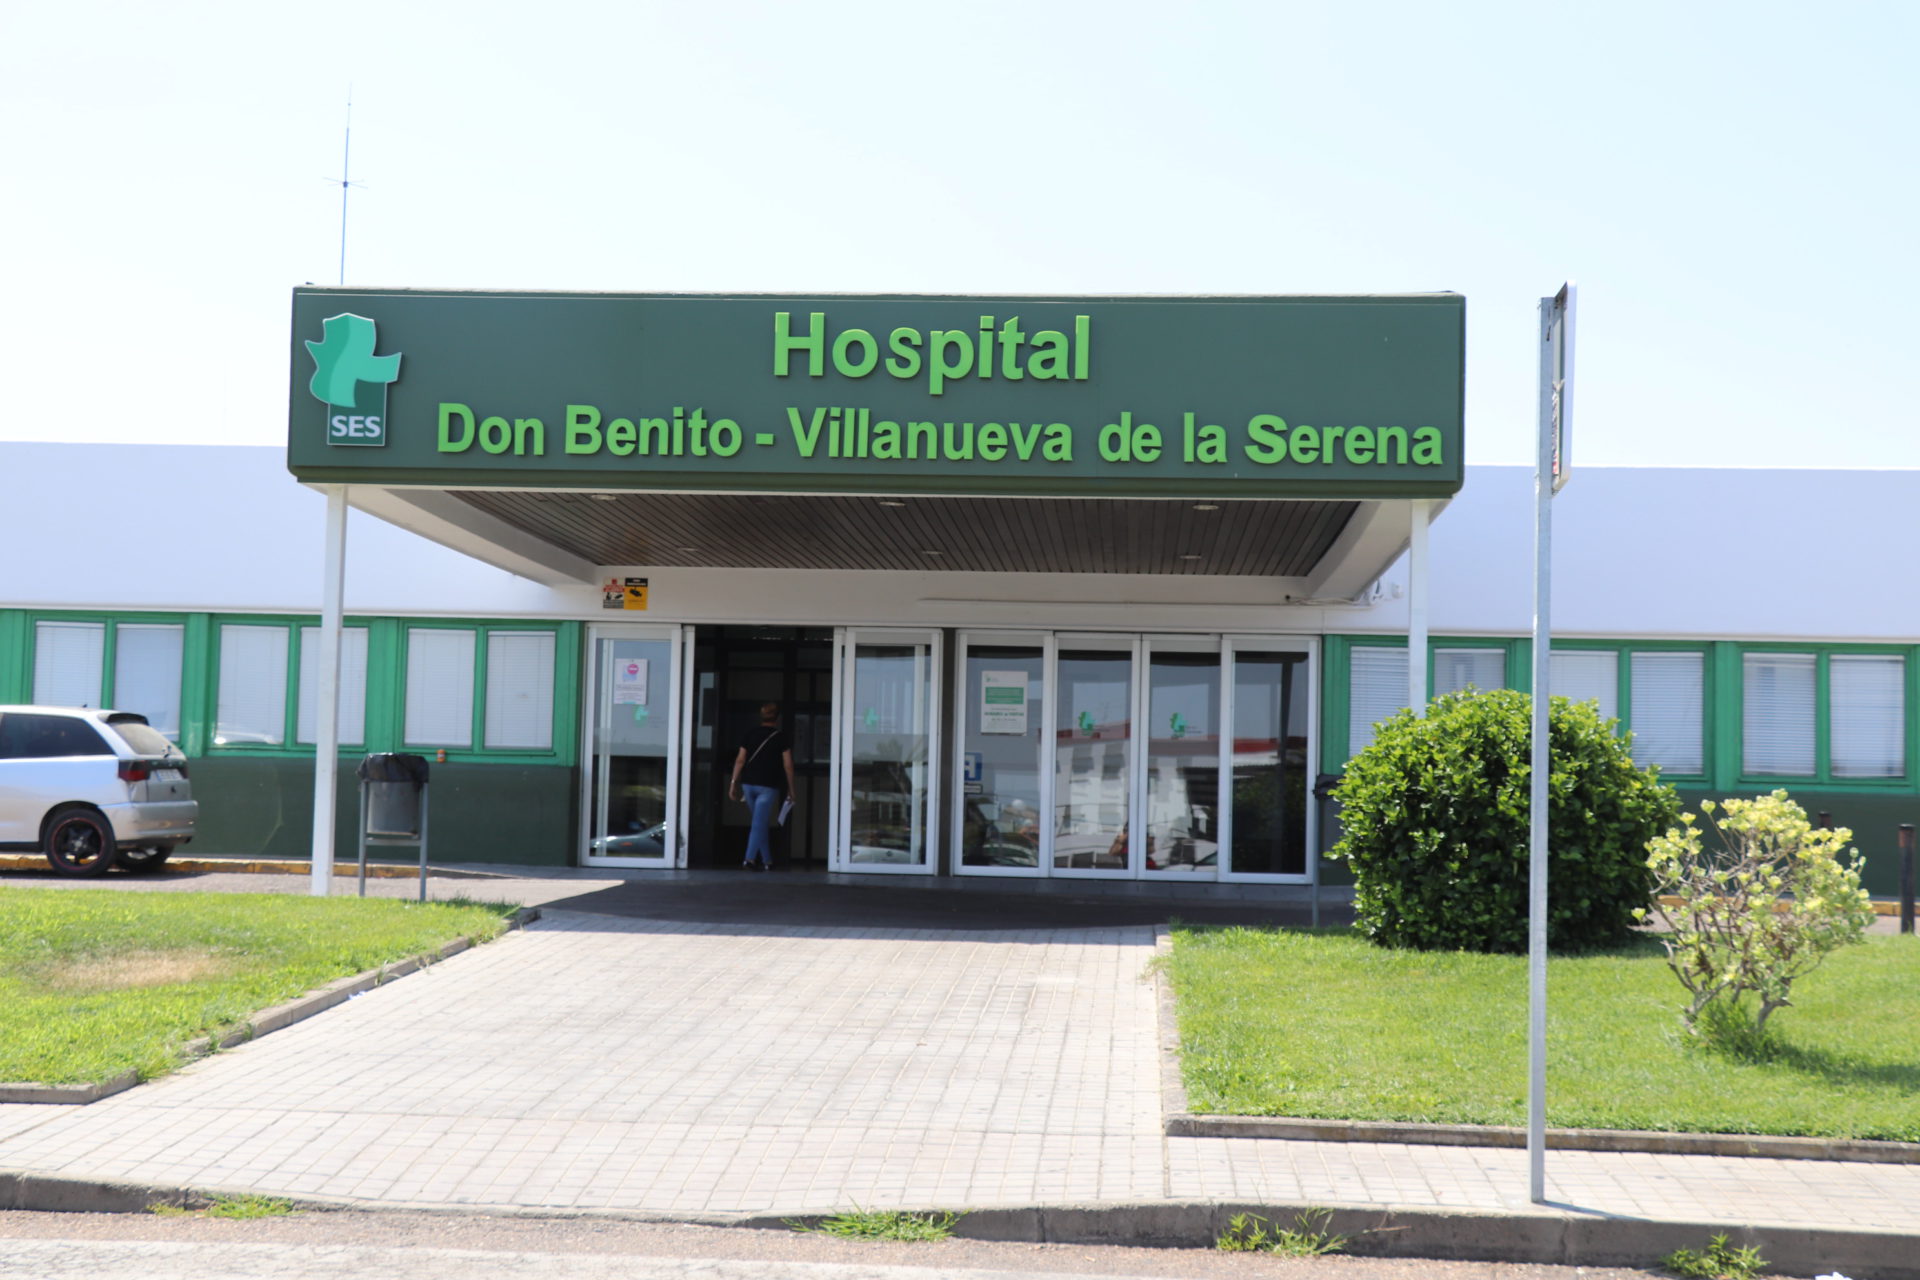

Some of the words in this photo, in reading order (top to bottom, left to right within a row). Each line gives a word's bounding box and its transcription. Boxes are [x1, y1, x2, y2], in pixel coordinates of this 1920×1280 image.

[773, 311, 1091, 395] Hospital
[331, 415, 381, 437] SES
[436, 402, 545, 456] Don
[564, 403, 743, 457] Benito
[754, 432, 775, 445] -
[786, 406, 1073, 463] Villanueva
[1097, 410, 1163, 463] de
[1183, 411, 1228, 464] la
[1243, 413, 1444, 466] Serena
